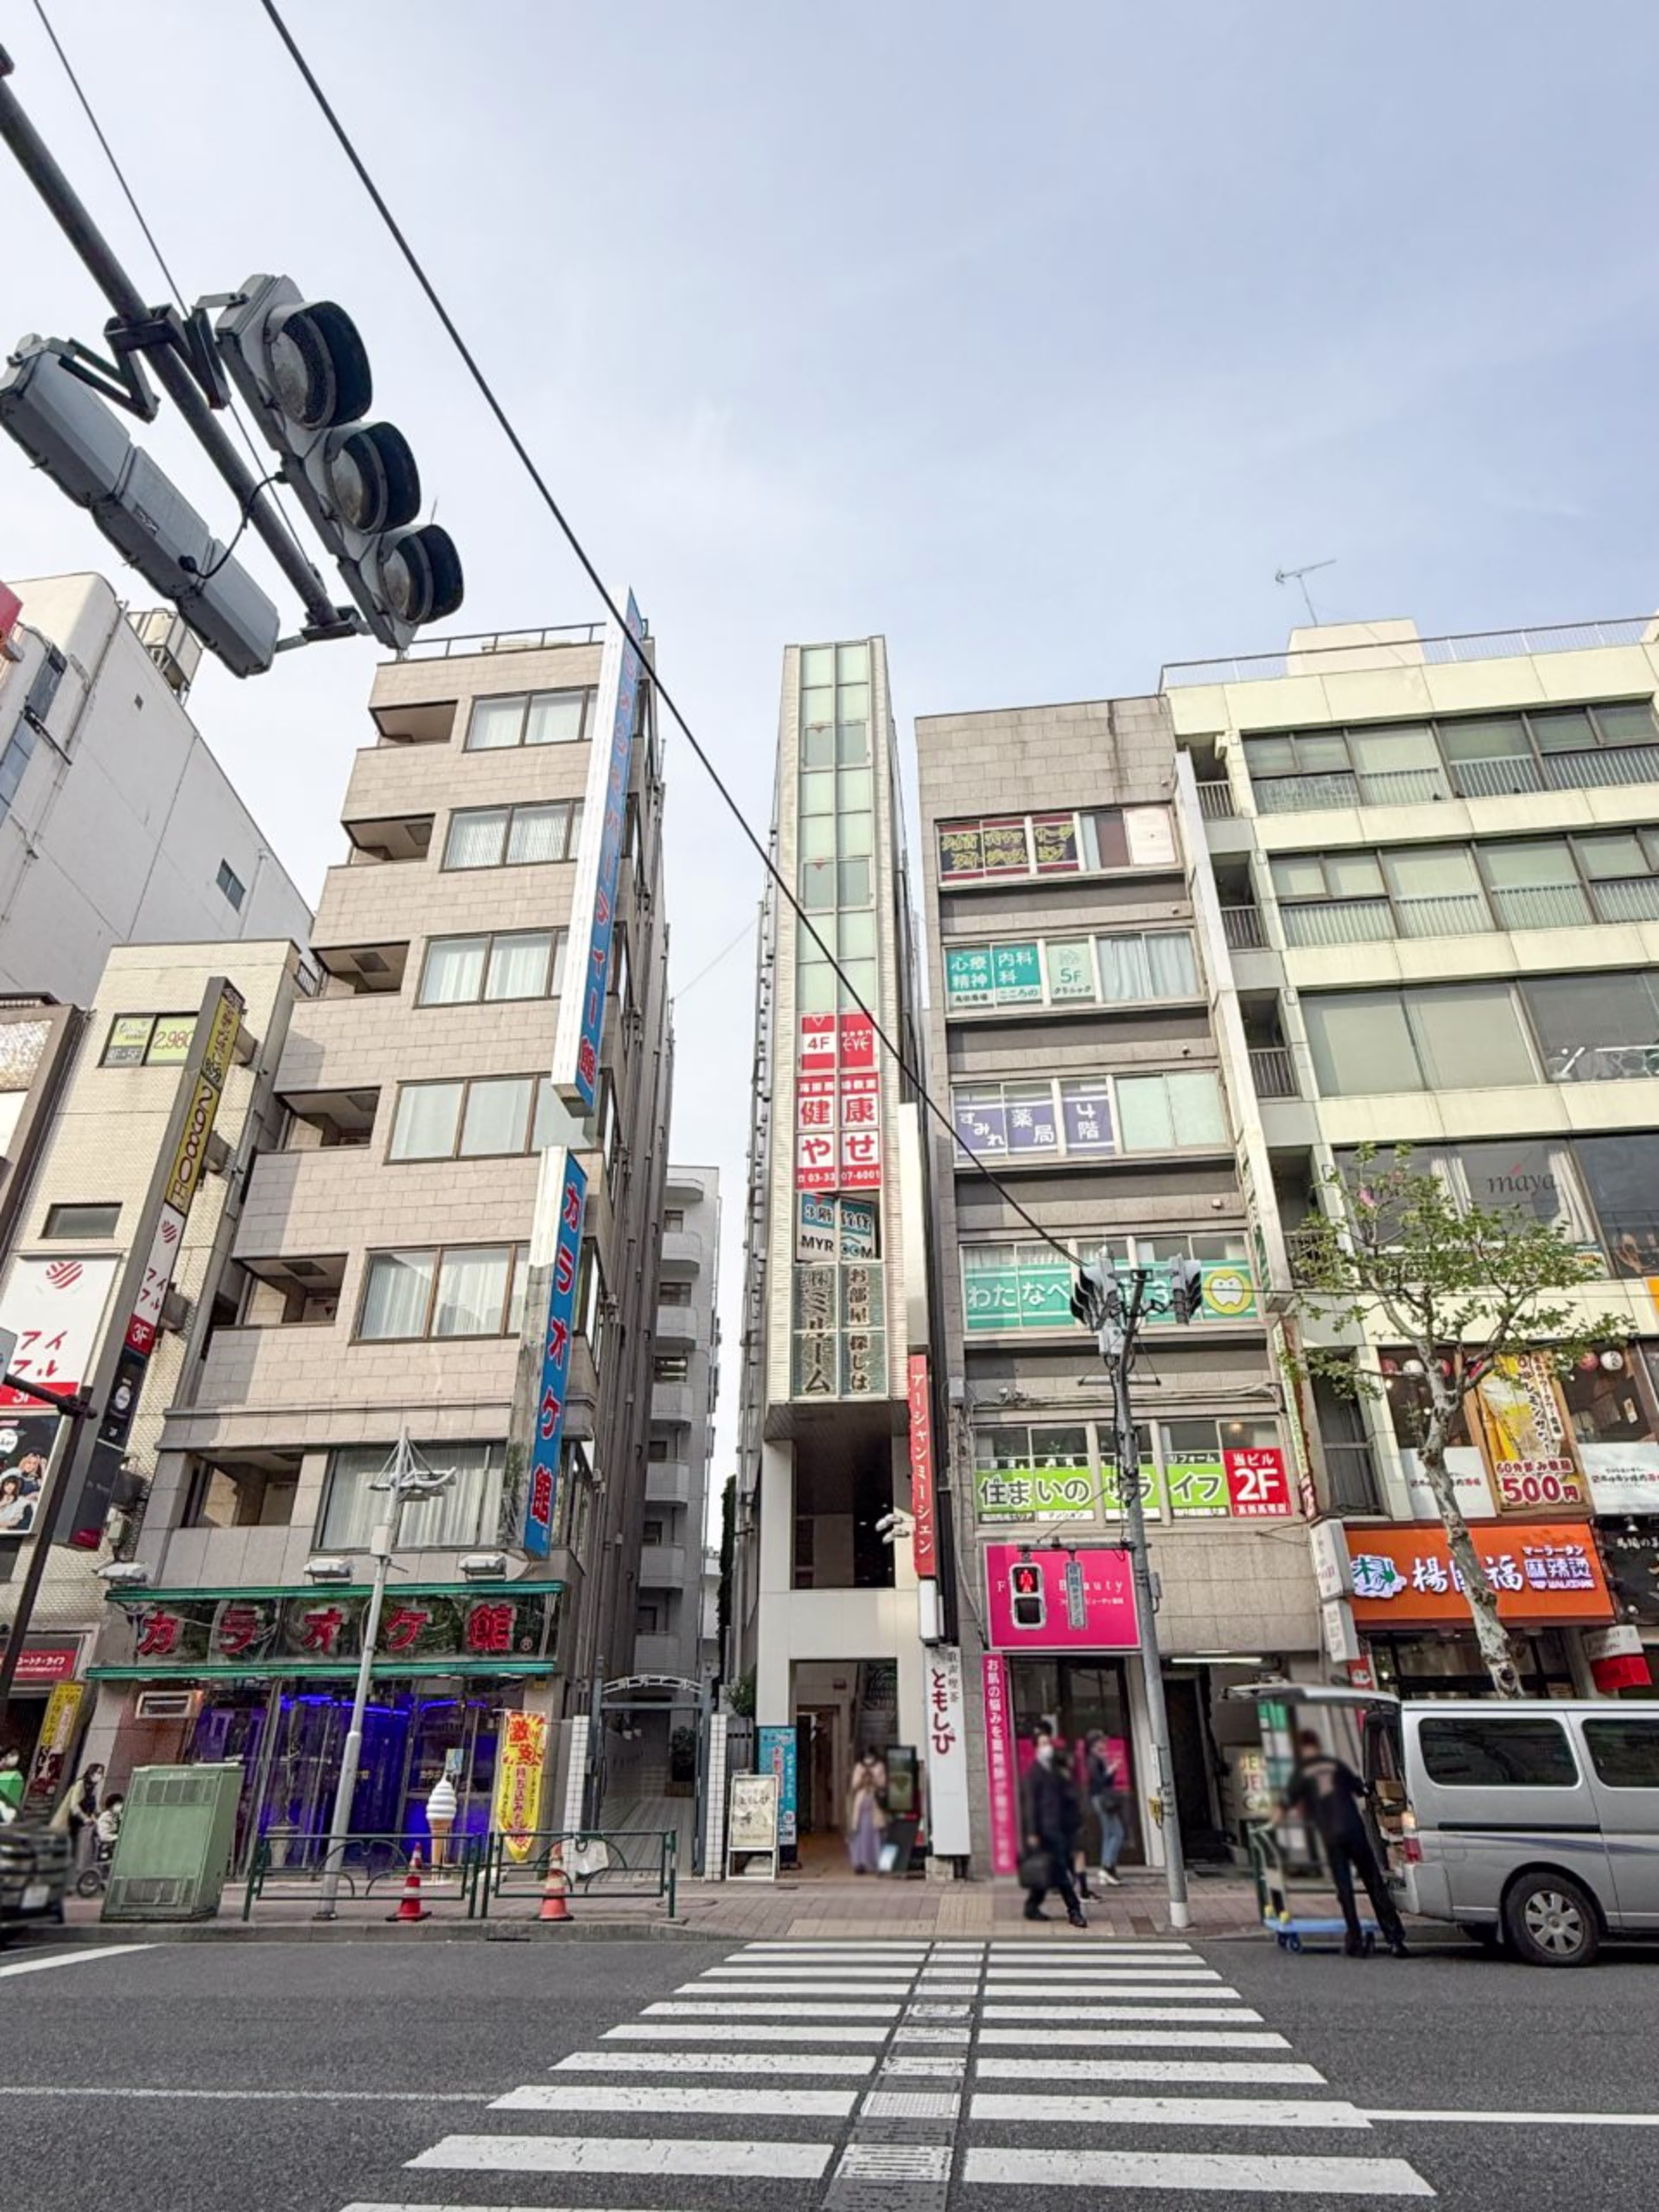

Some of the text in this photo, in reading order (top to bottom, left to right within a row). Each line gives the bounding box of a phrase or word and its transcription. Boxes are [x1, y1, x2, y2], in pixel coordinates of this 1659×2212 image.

[951, 951, 1034, 970] 心療内科
[952, 970, 1017, 989] 精神科
[1060, 968, 1081, 983] 5F
[807, 1037, 830, 1050] 4F
[801, 1098, 874, 1125] 健康
[1075, 1103, 1100, 1140] 4階
[959, 1108, 1055, 1146] すみれ薬局
[801, 1134, 875, 1165] やせ
[1488, 1173, 1556, 1195] maya
[530, 1181, 582, 1528] カラオケ館
[1233, 1452, 1275, 1465] 当ビル
[1234, 1468, 1280, 1501] 2F
[1501, 1474, 1580, 1503] 500円
[1058, 1579, 1123, 1593] Bauty
[137, 1603, 513, 1656] カラオケ館
[931, 1667, 956, 1755] ともしび
